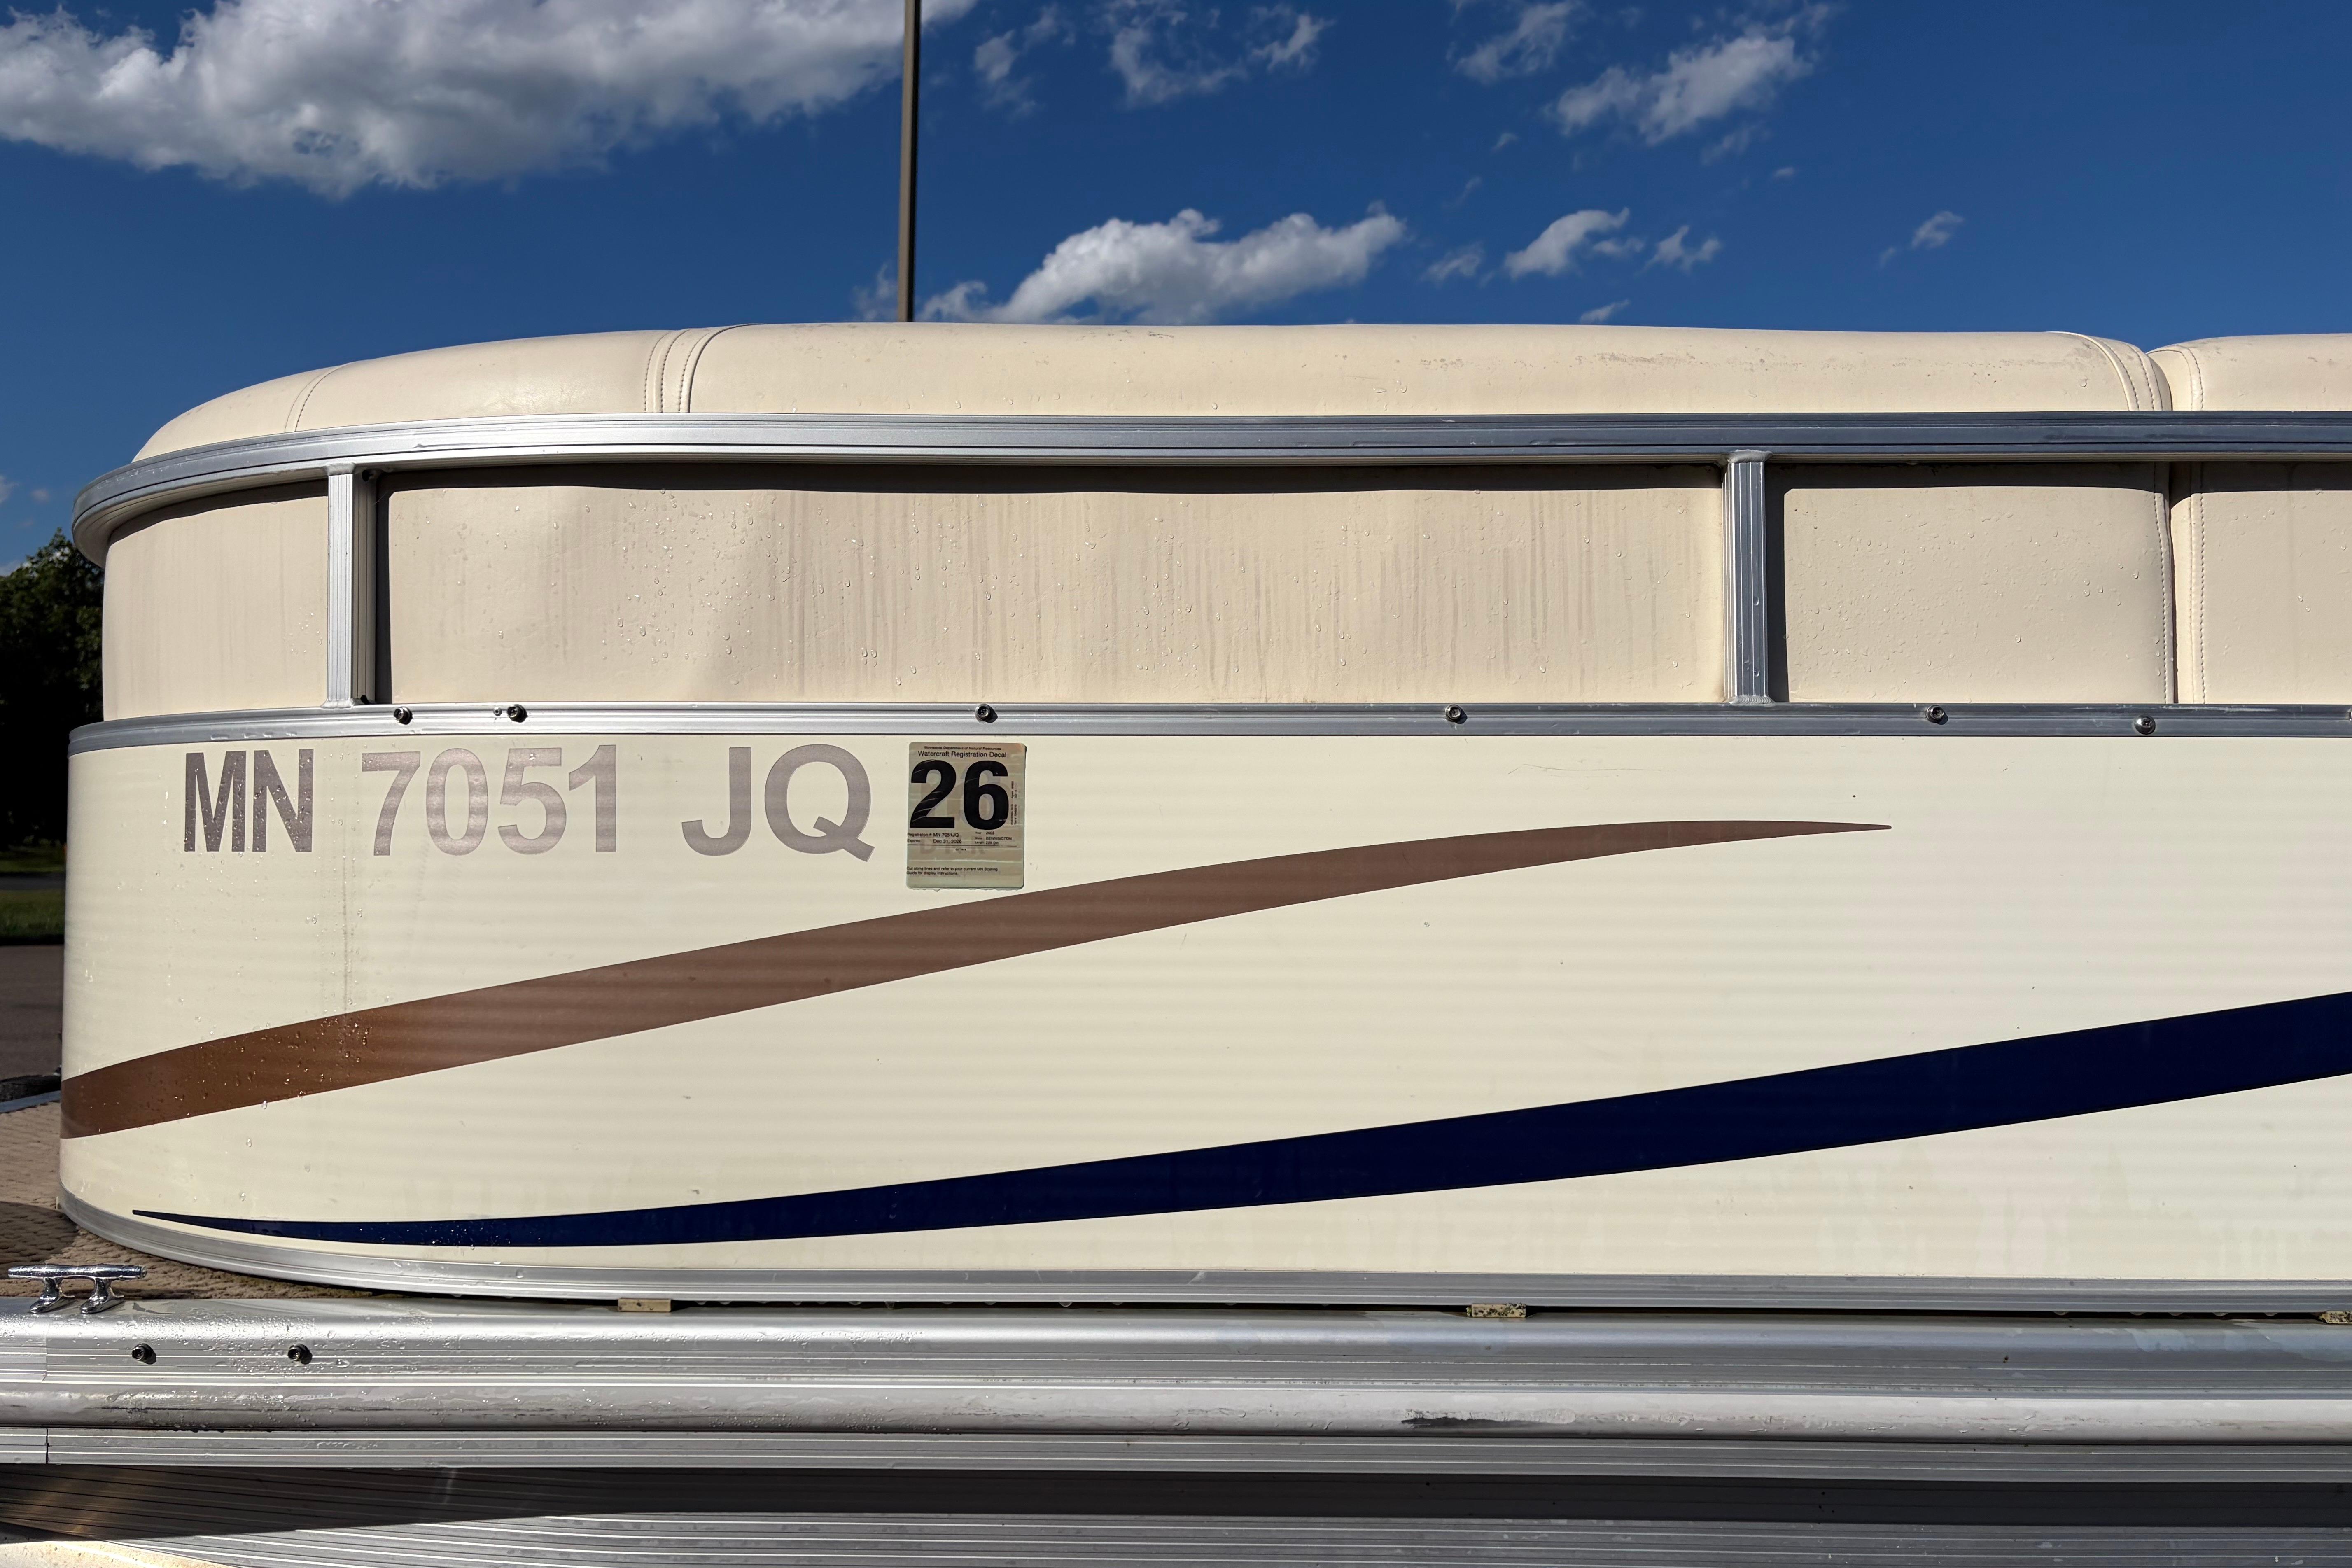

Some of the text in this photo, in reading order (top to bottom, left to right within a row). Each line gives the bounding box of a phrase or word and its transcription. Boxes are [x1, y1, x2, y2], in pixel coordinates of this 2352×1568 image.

[184, 743, 876, 863] MN 7051 JQ
[910, 759, 1009, 831] 26
